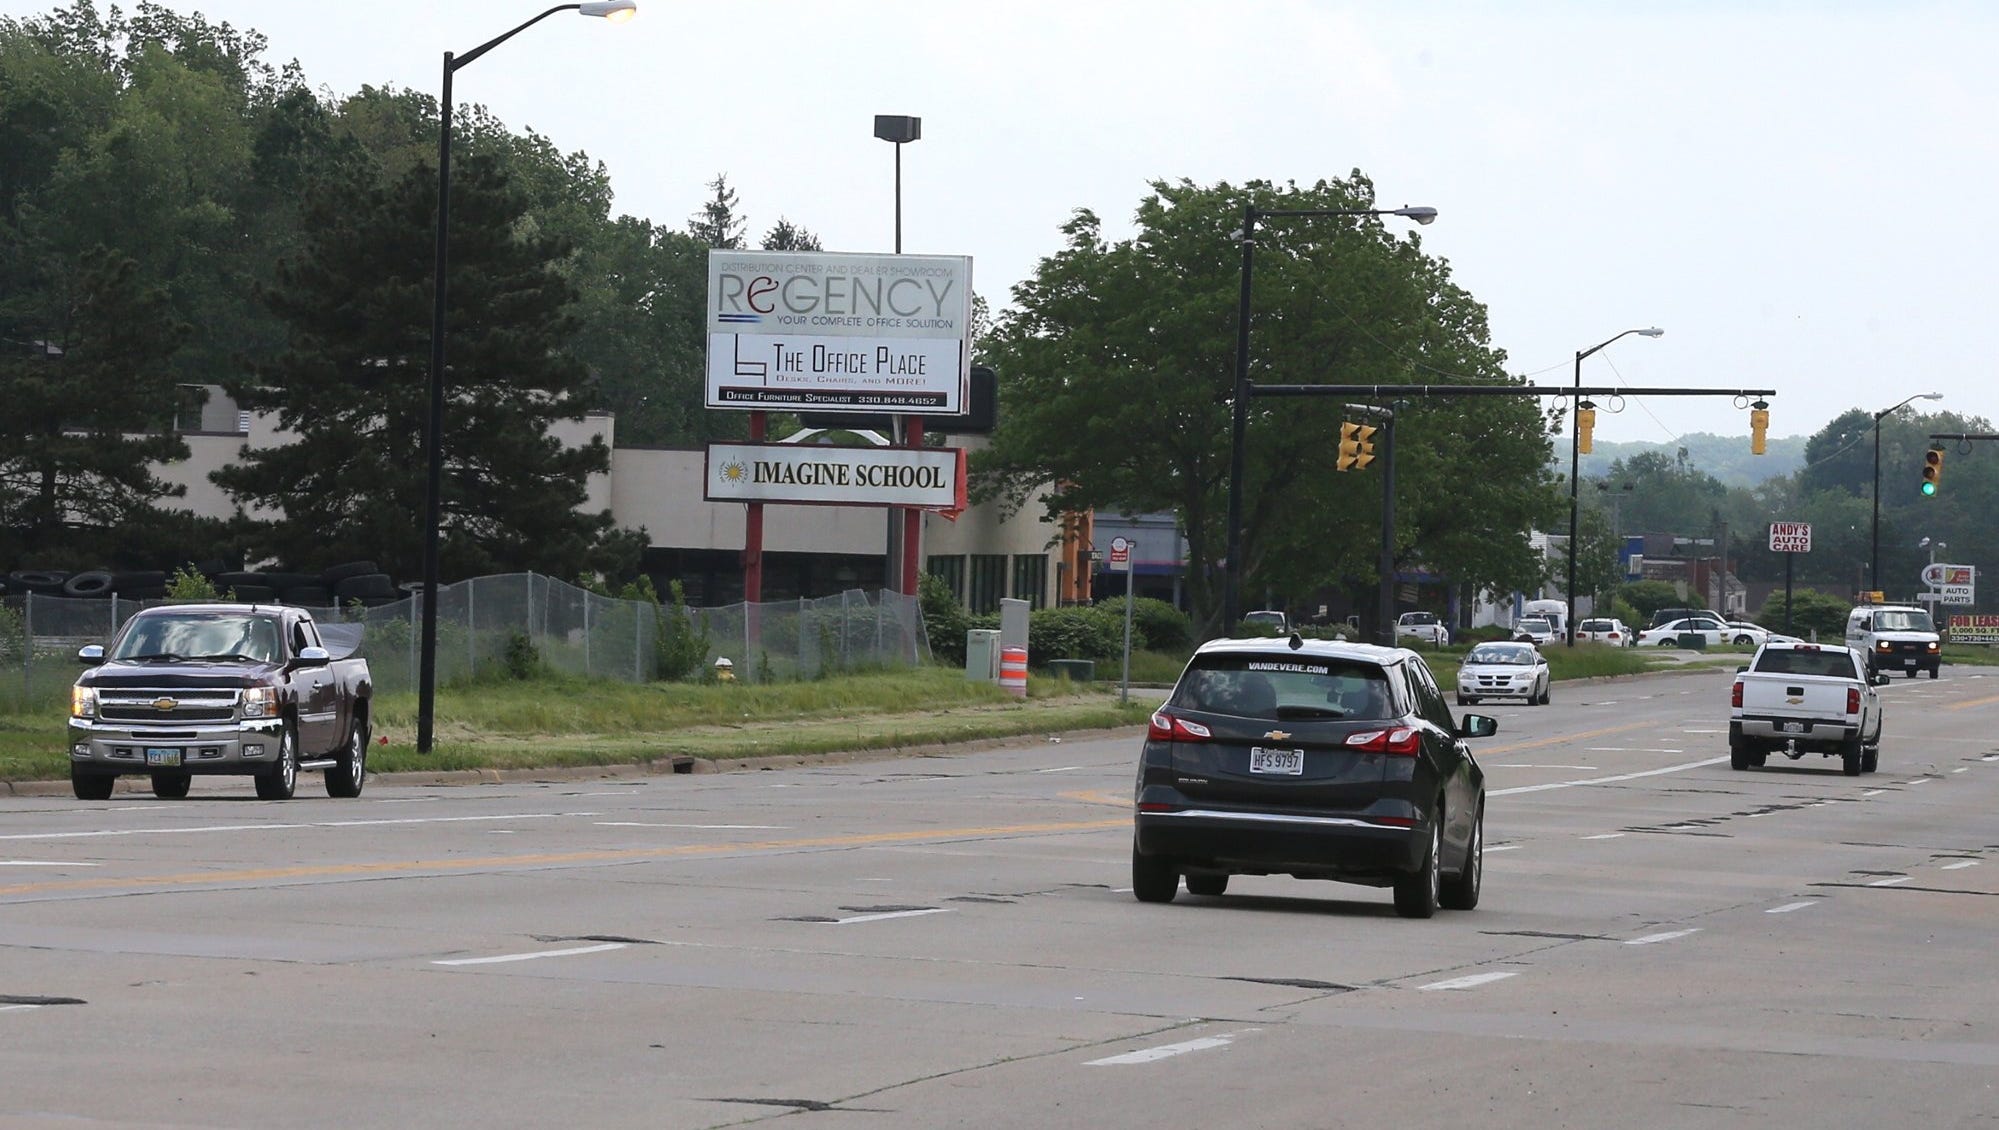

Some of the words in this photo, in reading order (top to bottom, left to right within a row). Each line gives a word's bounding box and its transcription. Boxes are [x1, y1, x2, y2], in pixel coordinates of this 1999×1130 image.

[785, 263, 823, 274] CENTER
[826, 264, 848, 275] AND
[777, 315, 808, 326] YOUR
[811, 316, 861, 327] COMPLETE
[866, 317, 901, 328] OFFICE
[906, 318, 953, 329] SOLUTION
[773, 343, 803, 373] THE
[813, 344, 867, 374] OFFICE
[876, 345, 926, 376] PLACE
[753, 461, 850, 486] IMAGINE
[855, 464, 946, 489] SCHOOL
[1773, 523, 1808, 536] ANDY'S
[1773, 536, 1808, 545] AUTO
[1773, 543, 1808, 552] CARE
[1946, 587, 1969, 595] AUTO
[1943, 595, 1971, 603] PARTS
[1951, 615, 1971, 627] FOR
[1972, 615, 1999, 628] LEAS
[1248, 662, 1329, 675] VANDEVERE.COM
[1254, 754, 1273, 767] HFS
[1275, 754, 1299, 768] 9797
